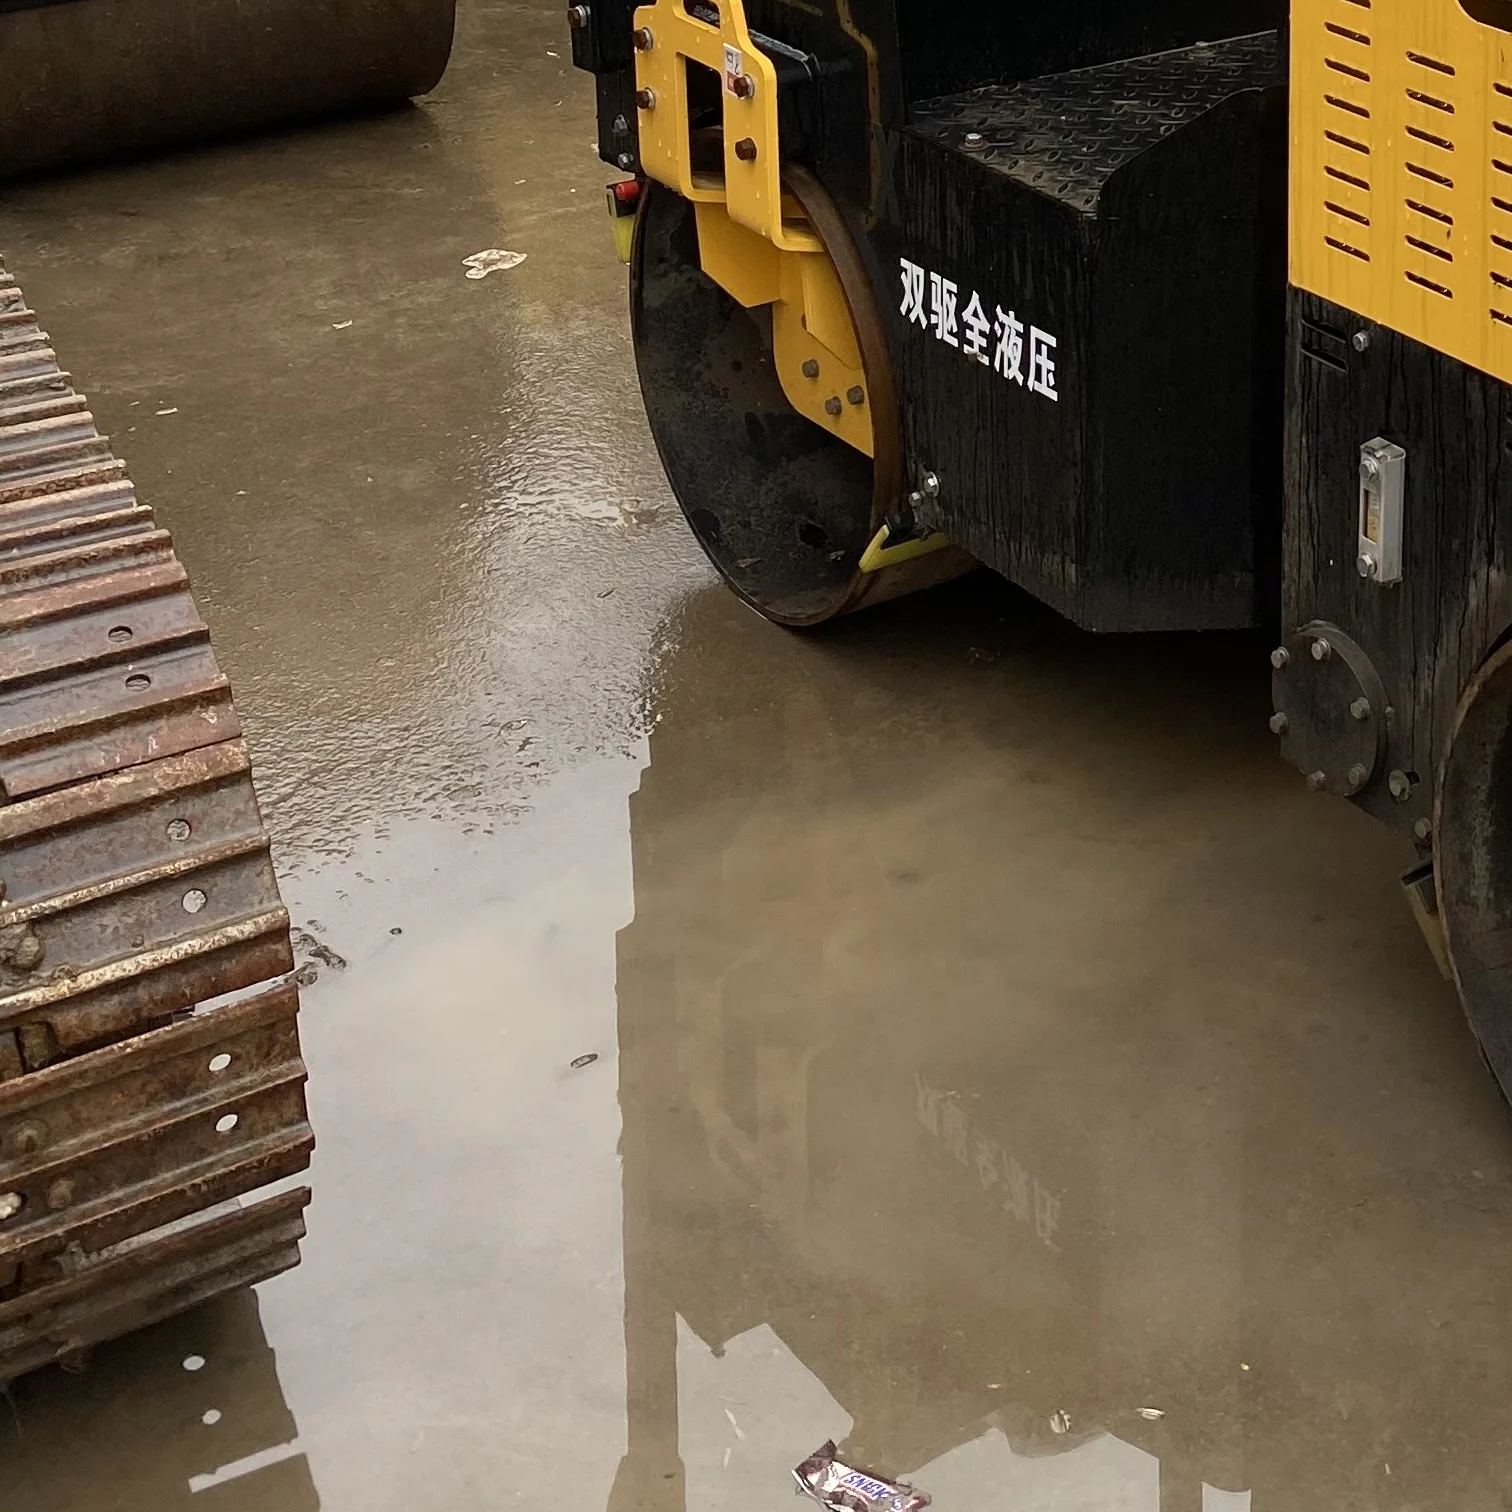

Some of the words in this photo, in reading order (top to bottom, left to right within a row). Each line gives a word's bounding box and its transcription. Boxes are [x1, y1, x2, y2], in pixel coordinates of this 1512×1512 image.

[899, 257, 1058, 402] 双驱全液压
